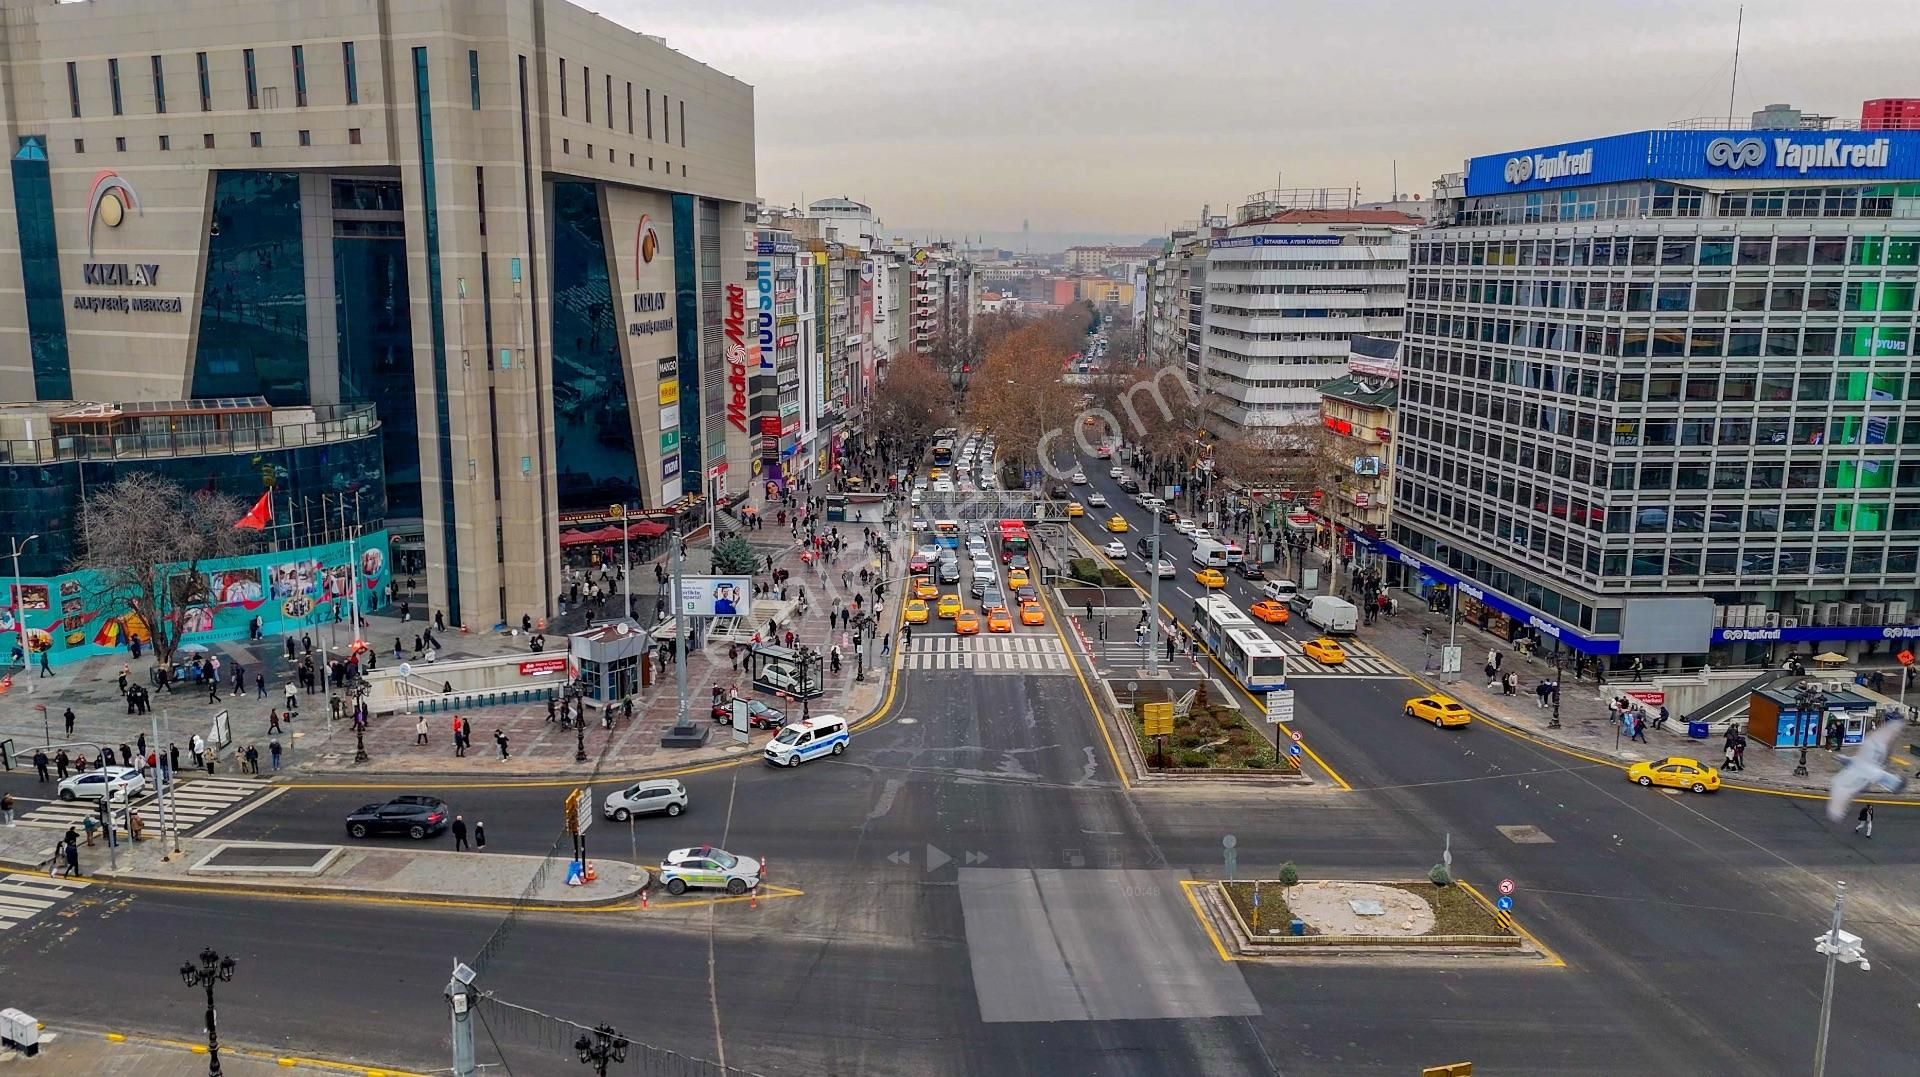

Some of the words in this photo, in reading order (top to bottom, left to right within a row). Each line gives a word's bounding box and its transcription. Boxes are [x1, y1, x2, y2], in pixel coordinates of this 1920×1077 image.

[83, 264, 160, 286] KIZILAY
[74, 295, 129, 314] ALIŞVERİŞ
[132, 297, 182, 313] MERKEZİ
[634, 292, 666, 313] KIZILAY
[660, 361, 676, 372] MANGO
[664, 457, 678, 475] mavi
